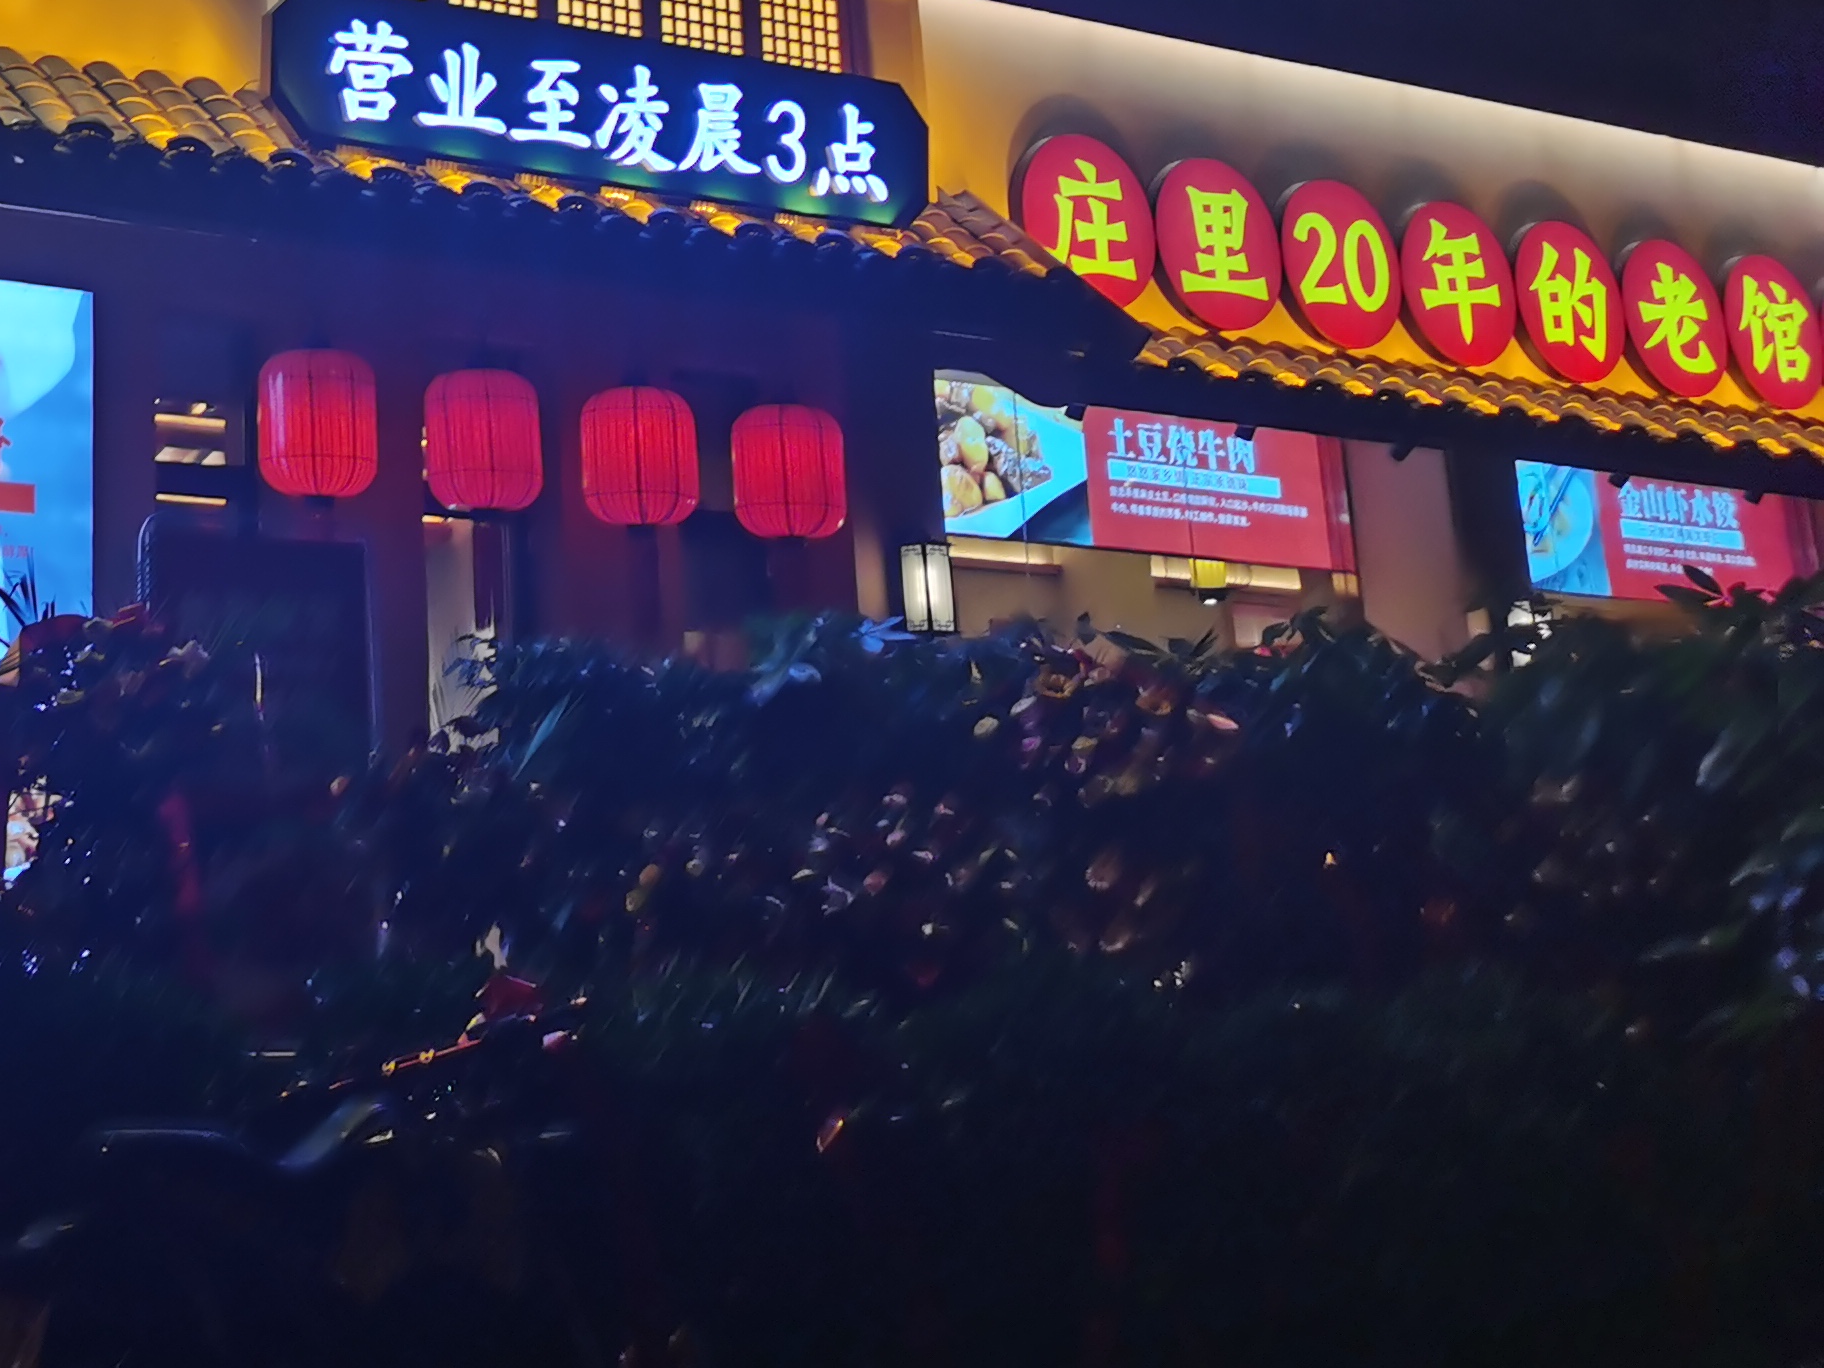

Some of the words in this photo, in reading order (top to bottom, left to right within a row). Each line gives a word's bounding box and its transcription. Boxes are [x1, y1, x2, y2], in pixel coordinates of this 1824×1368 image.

[328, 19, 889, 204] 营业至凌晨3点
[1048, 157, 1811, 384] 庄里20年的老馆
[1106, 417, 1255, 474] 土豆烧牛肉
